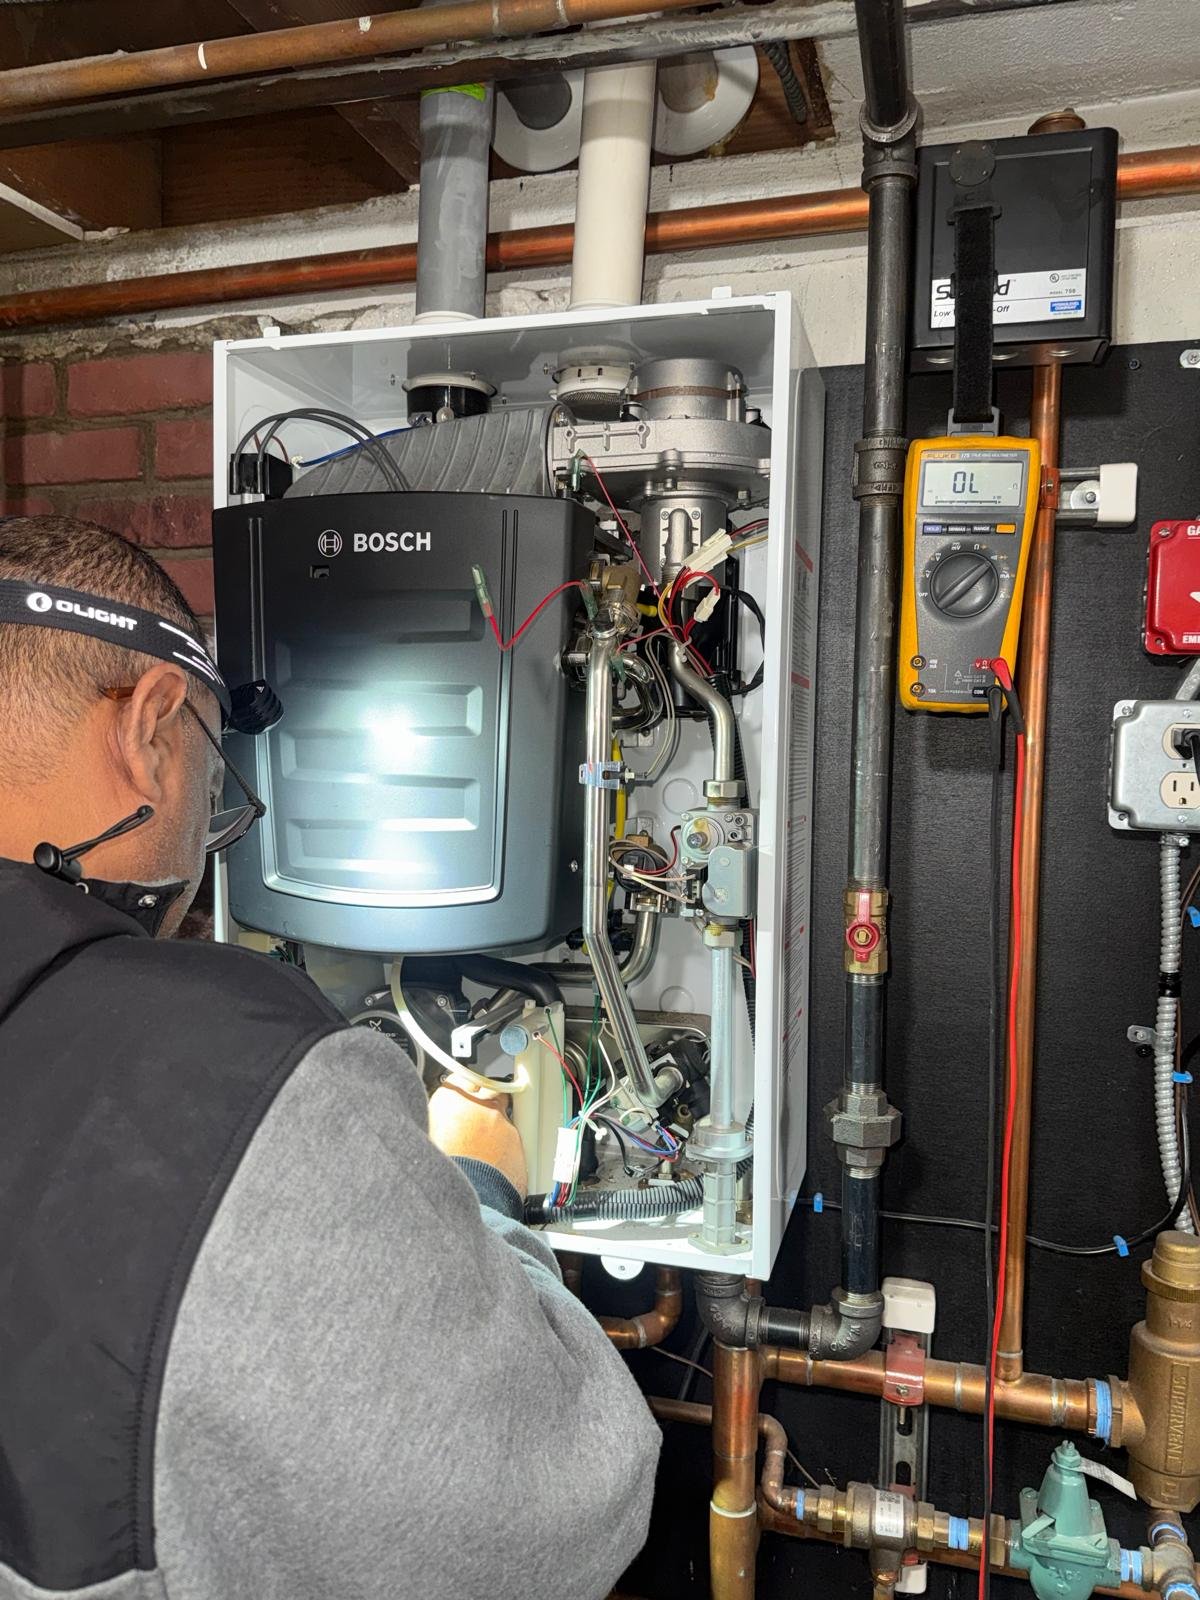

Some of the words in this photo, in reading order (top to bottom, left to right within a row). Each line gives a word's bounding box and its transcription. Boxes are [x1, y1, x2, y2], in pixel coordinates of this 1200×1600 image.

[934, 310, 951, 318] Low
[353, 531, 431, 552] BOSCH
[56, 600, 137, 631] OLIGHT
